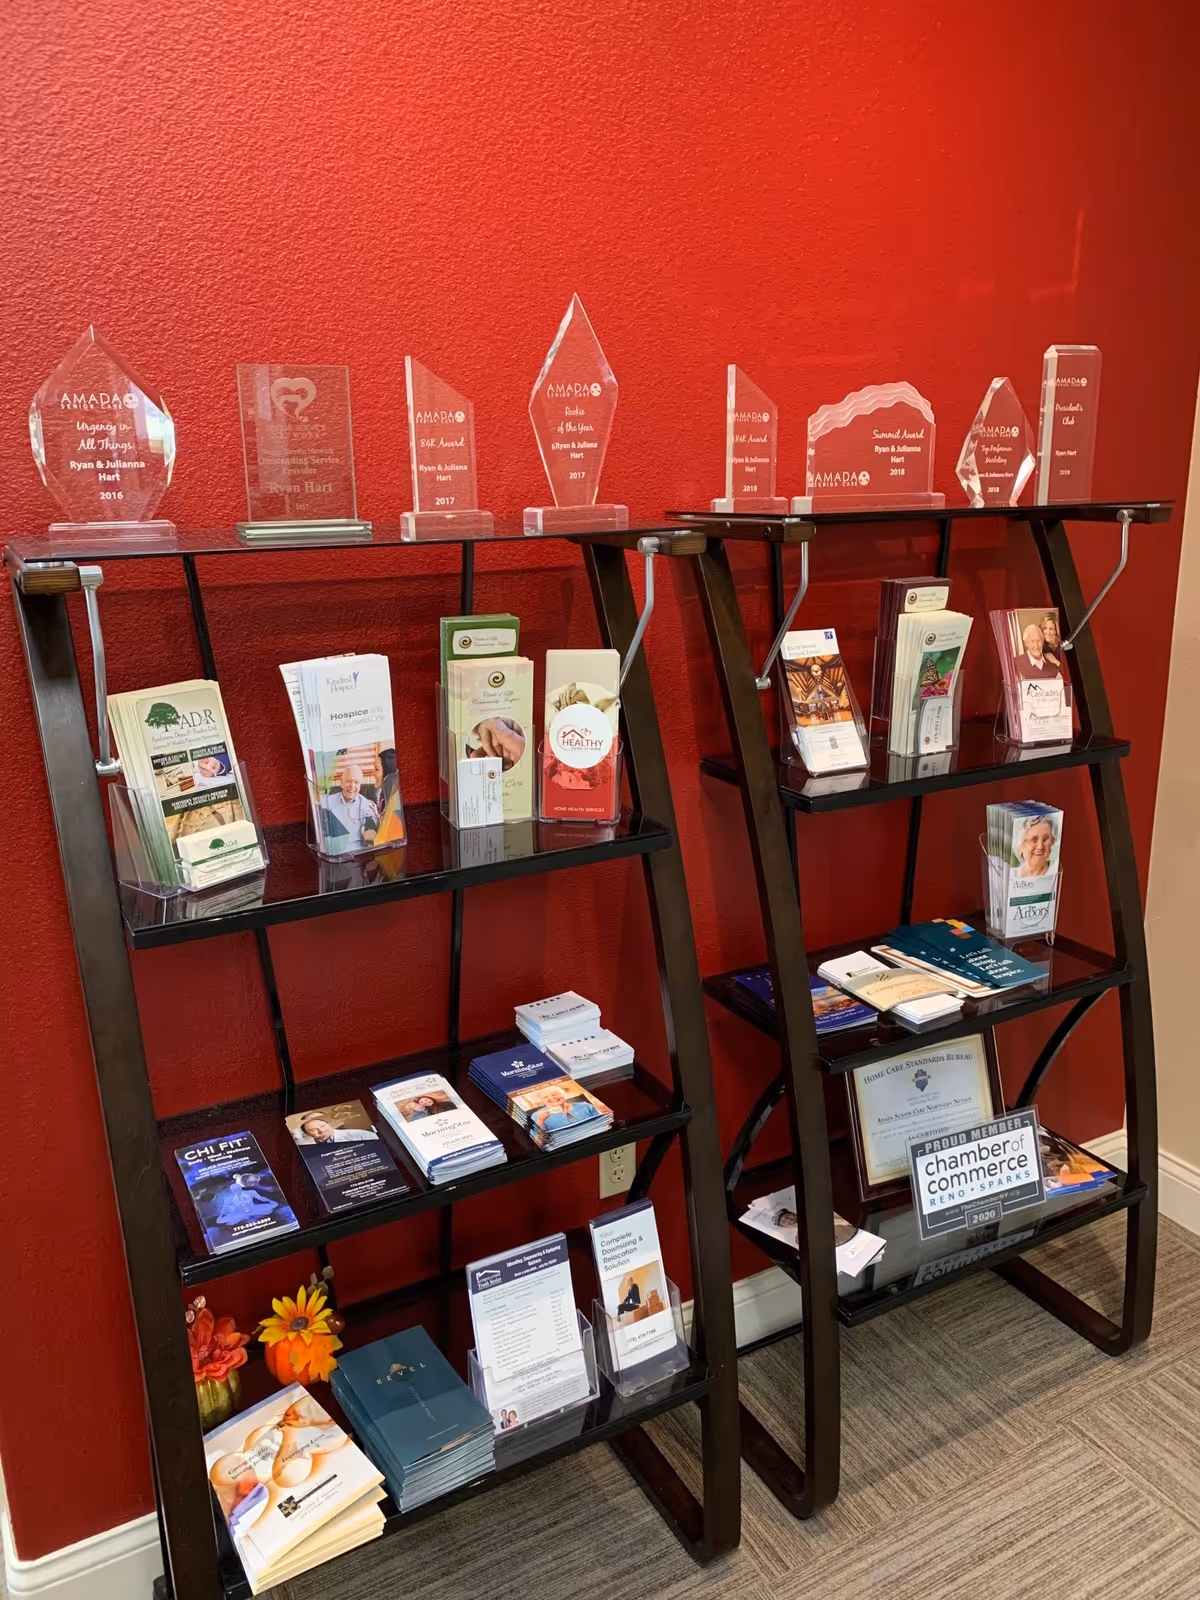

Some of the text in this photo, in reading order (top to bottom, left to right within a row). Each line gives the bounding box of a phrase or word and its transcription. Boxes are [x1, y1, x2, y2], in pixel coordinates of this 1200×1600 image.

[547, 383, 590, 393] AMADA
[60, 392, 122, 404] AMADA
[565, 405, 585, 416] Rookie
[1055, 403, 1084, 412] President's
[416, 411, 455, 420] AMADA
[735, 412, 762, 420] AMADA
[1062, 416, 1075, 425] Club
[76, 421, 133, 435] Urgency in
[557, 421, 594, 434] of the Year
[983, 426, 1011, 434] AMADA
[746, 434, 768, 444] Award
[872, 428, 925, 440] Summit Award
[77, 438, 134, 454] All Things
[420, 436, 465, 448] 84K Award
[556, 442, 570, 450] Ryan
[874, 445, 890, 454] Ryan
[70, 460, 146, 471] Ryan & Julianna
[310, 456, 340, 464] Service
[419, 464, 436, 472] Ryan
[98, 472, 121, 481] Hart
[814, 471, 858, 482] AMADA
[270, 482, 333, 494] Ryan Hart
[100, 491, 124, 500] 2016
[435, 498, 456, 506] 2017
[326, 675, 352, 686] Kindred
[330, 708, 368, 721] Hospice
[562, 739, 604, 748] HEALTHY
[980, 962, 998, 972] Let's
[988, 966, 1009, 976] about
[500, 1062, 544, 1077] MorningStar
[863, 1053, 974, 1084] HOME CARE STANDARDS BUREAU
[422, 1120, 472, 1138] MorningStar
[924, 1133, 967, 1154] PROUD
[970, 1118, 1022, 1140] MEMBER
[184, 1138, 244, 1161] CHI FIT
[924, 1133, 1025, 1177] chamber of
[188, 1158, 204, 1166] Body
[226, 1146, 251, 1154] Wellness
[210, 1154, 233, 1163] Training
[198, 1164, 217, 1173] BRUCE
[927, 1153, 1028, 1195] commerce
[929, 1170, 1032, 1207] RENO SPARKS
[972, 1210, 996, 1224] 2020
[599, 1230, 614, 1238] Your
[600, 1231, 632, 1248] Complete
[601, 1238, 638, 1256] Downsizing
[602, 1246, 638, 1264] Relocation
[604, 1258, 631, 1272] Solution
[376, 1362, 426, 1385] REVEL
[282, 1433, 325, 1463] Improving Lives
[228, 1460, 248, 1475] Caring
[231, 1466, 252, 1480] Serving
